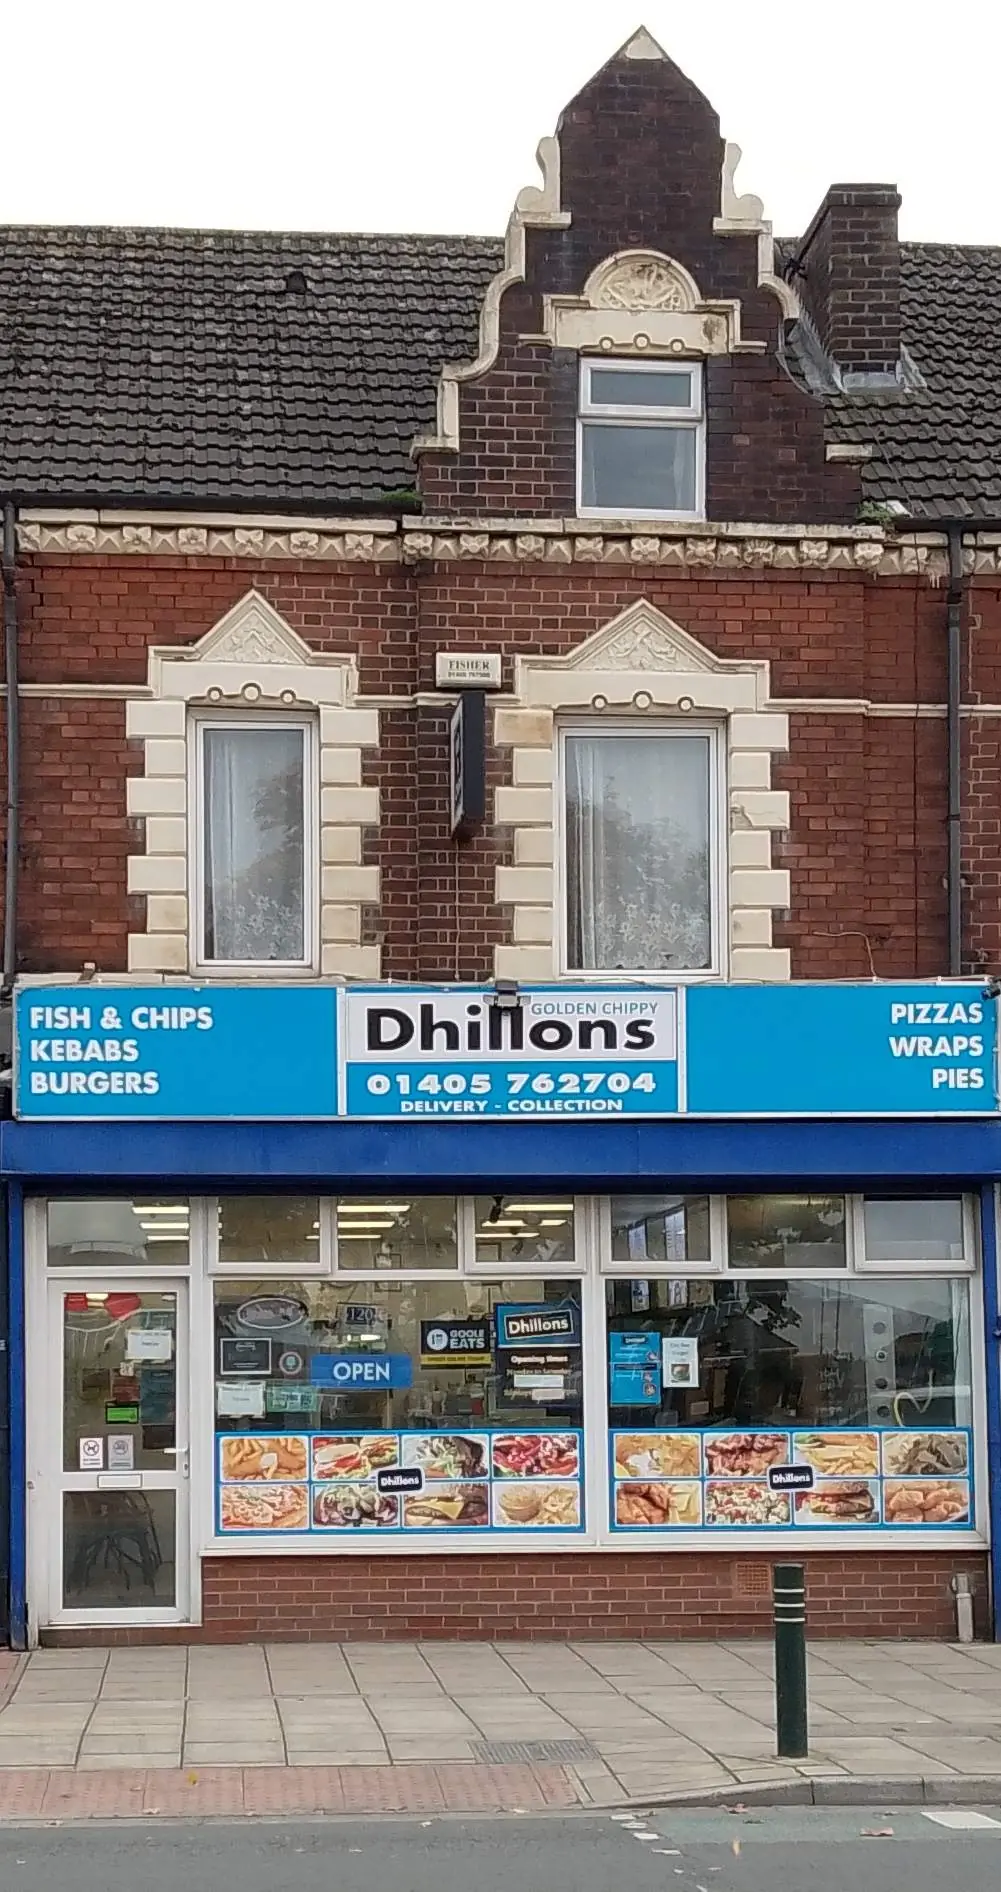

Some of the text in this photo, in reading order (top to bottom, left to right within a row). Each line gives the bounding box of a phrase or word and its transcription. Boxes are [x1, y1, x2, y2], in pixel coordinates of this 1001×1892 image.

[448, 660, 490, 670] FISHER
[30, 1006, 214, 1030] FISH & CHIPS
[531, 1002, 658, 1016] GOLDEN CHIPPY
[891, 1003, 983, 1024] PIZZAS
[366, 1003, 656, 1051] Dhillons
[30, 1039, 139, 1062] KEBABS
[889, 1035, 984, 1057] WRAPS
[31, 1071, 160, 1094] BURGERS
[366, 1072, 656, 1095] 01405 762704
[932, 1067, 985, 1089] PIES
[401, 1100, 488, 1113] DELIVERY
[507, 1099, 623, 1112] COLLECTION
[450, 1329, 485, 1338] GOOLE
[509, 1317, 569, 1335] Dhillons
[450, 1338, 486, 1349] EATS
[333, 1362, 390, 1381] OPEN
[380, 1475, 420, 1487] Dhillons
[772, 1472, 811, 1484] Dhillons
